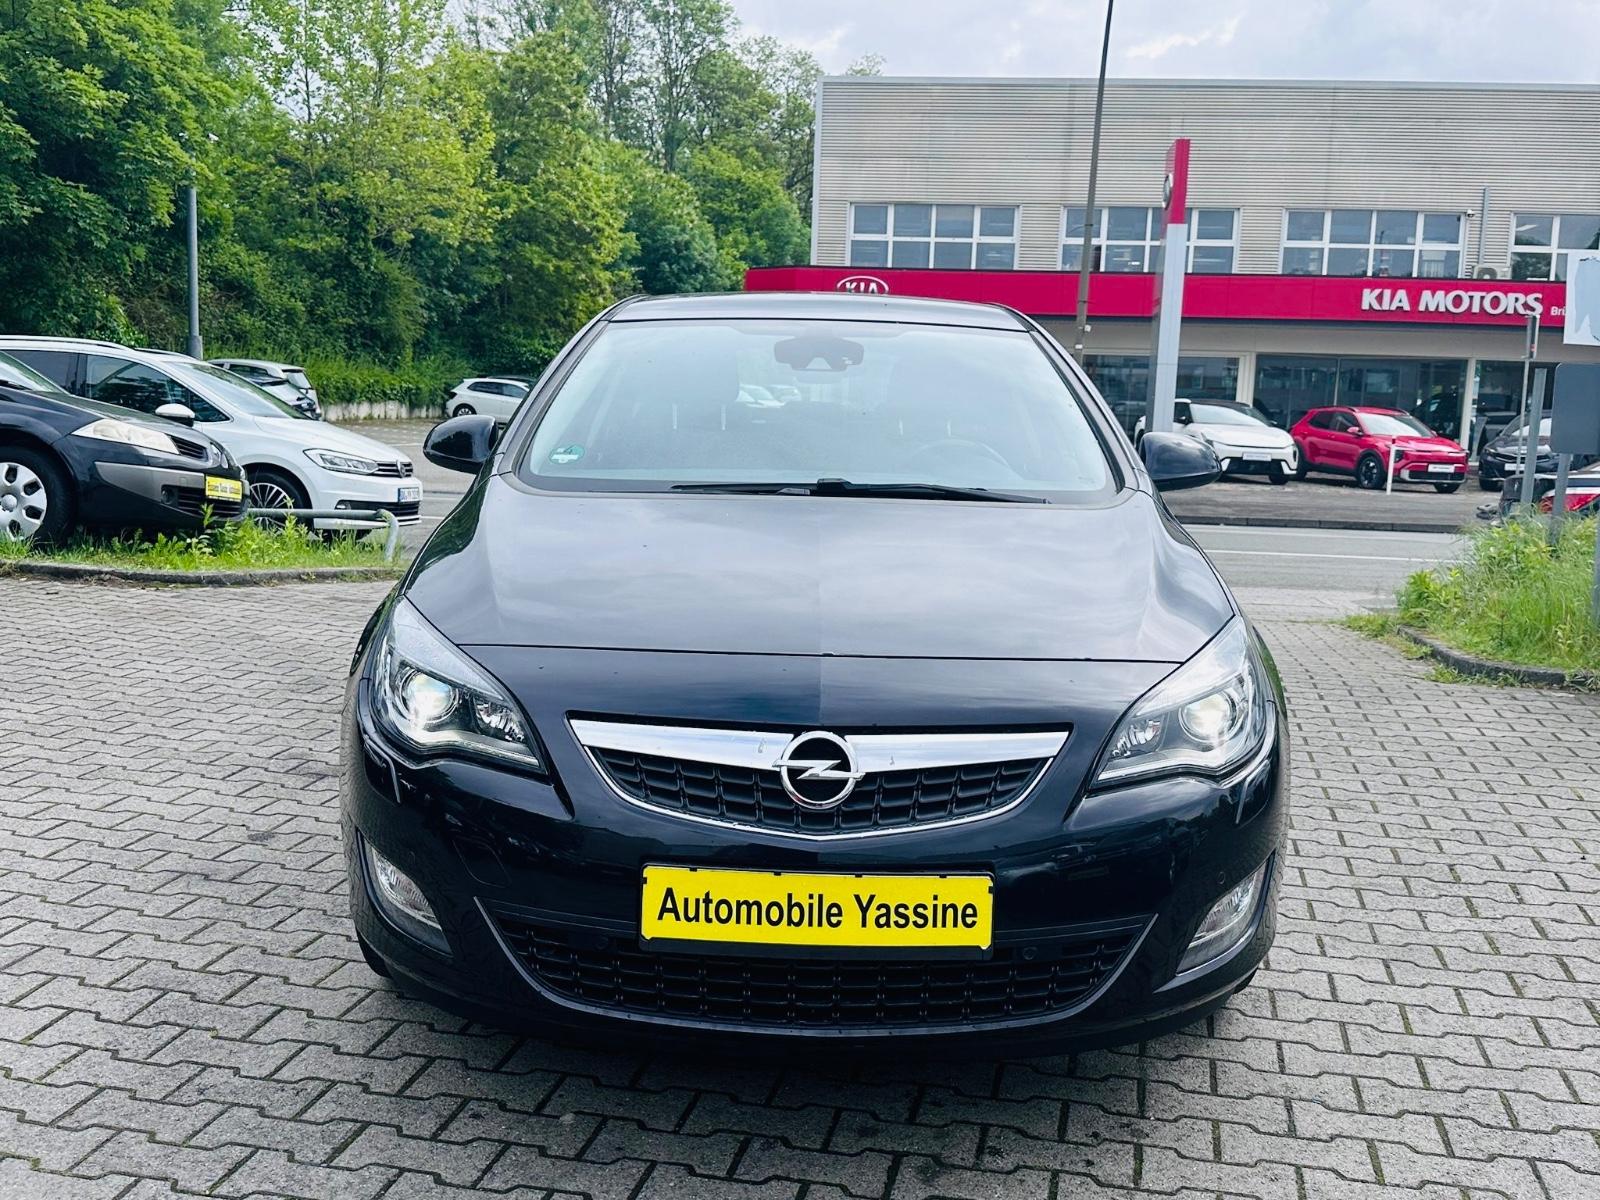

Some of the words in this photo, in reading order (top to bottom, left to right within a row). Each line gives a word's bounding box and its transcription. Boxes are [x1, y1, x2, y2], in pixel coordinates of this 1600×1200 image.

[845, 282, 878, 294] KIA
[1361, 288, 1410, 311] KIA
[1418, 290, 1543, 315] MOTORS
[657, 887, 843, 928] Automobile
[853, 893, 978, 929] Yassine
